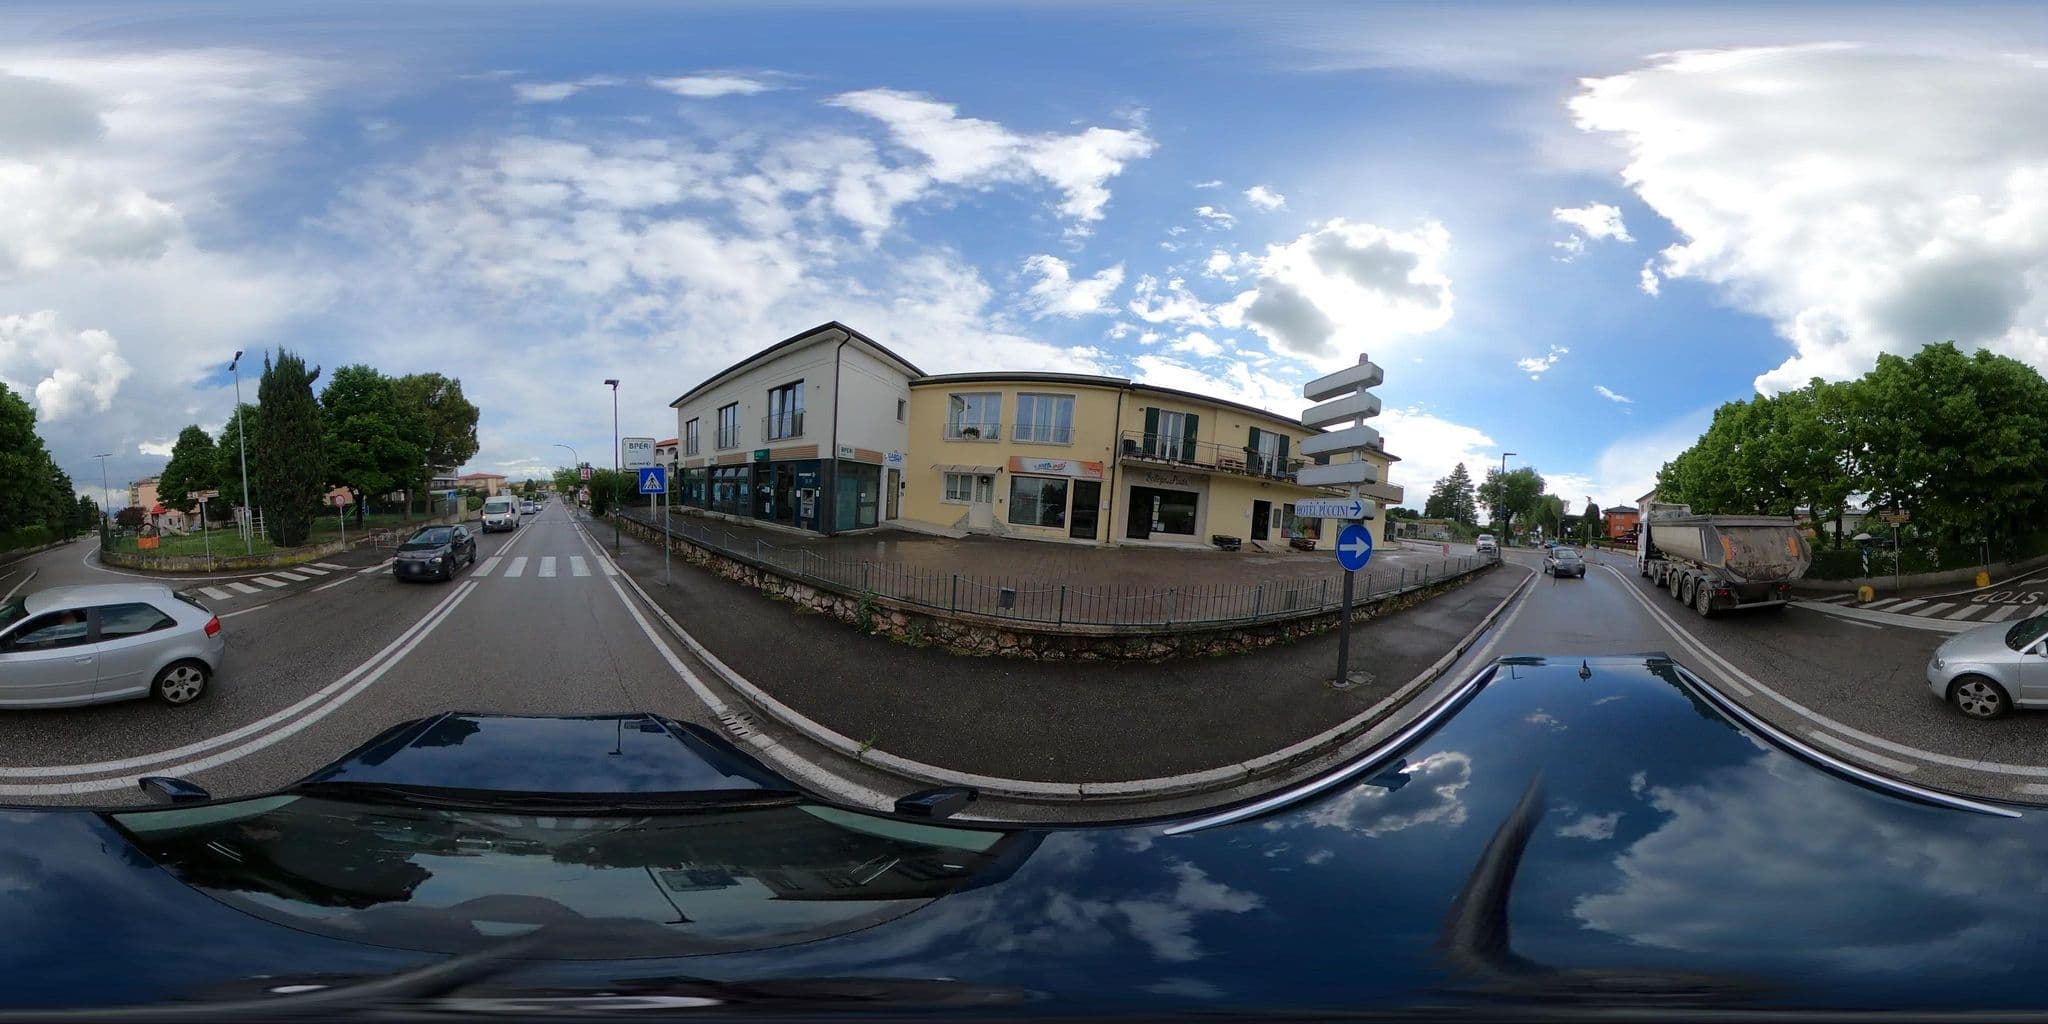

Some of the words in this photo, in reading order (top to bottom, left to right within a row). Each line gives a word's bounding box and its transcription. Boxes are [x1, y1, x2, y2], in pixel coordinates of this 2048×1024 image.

[1296, 504, 1316, 516] HOTEL
[1319, 504, 1348, 517] PUCCINI
[1971, 591, 2044, 604] STOP
